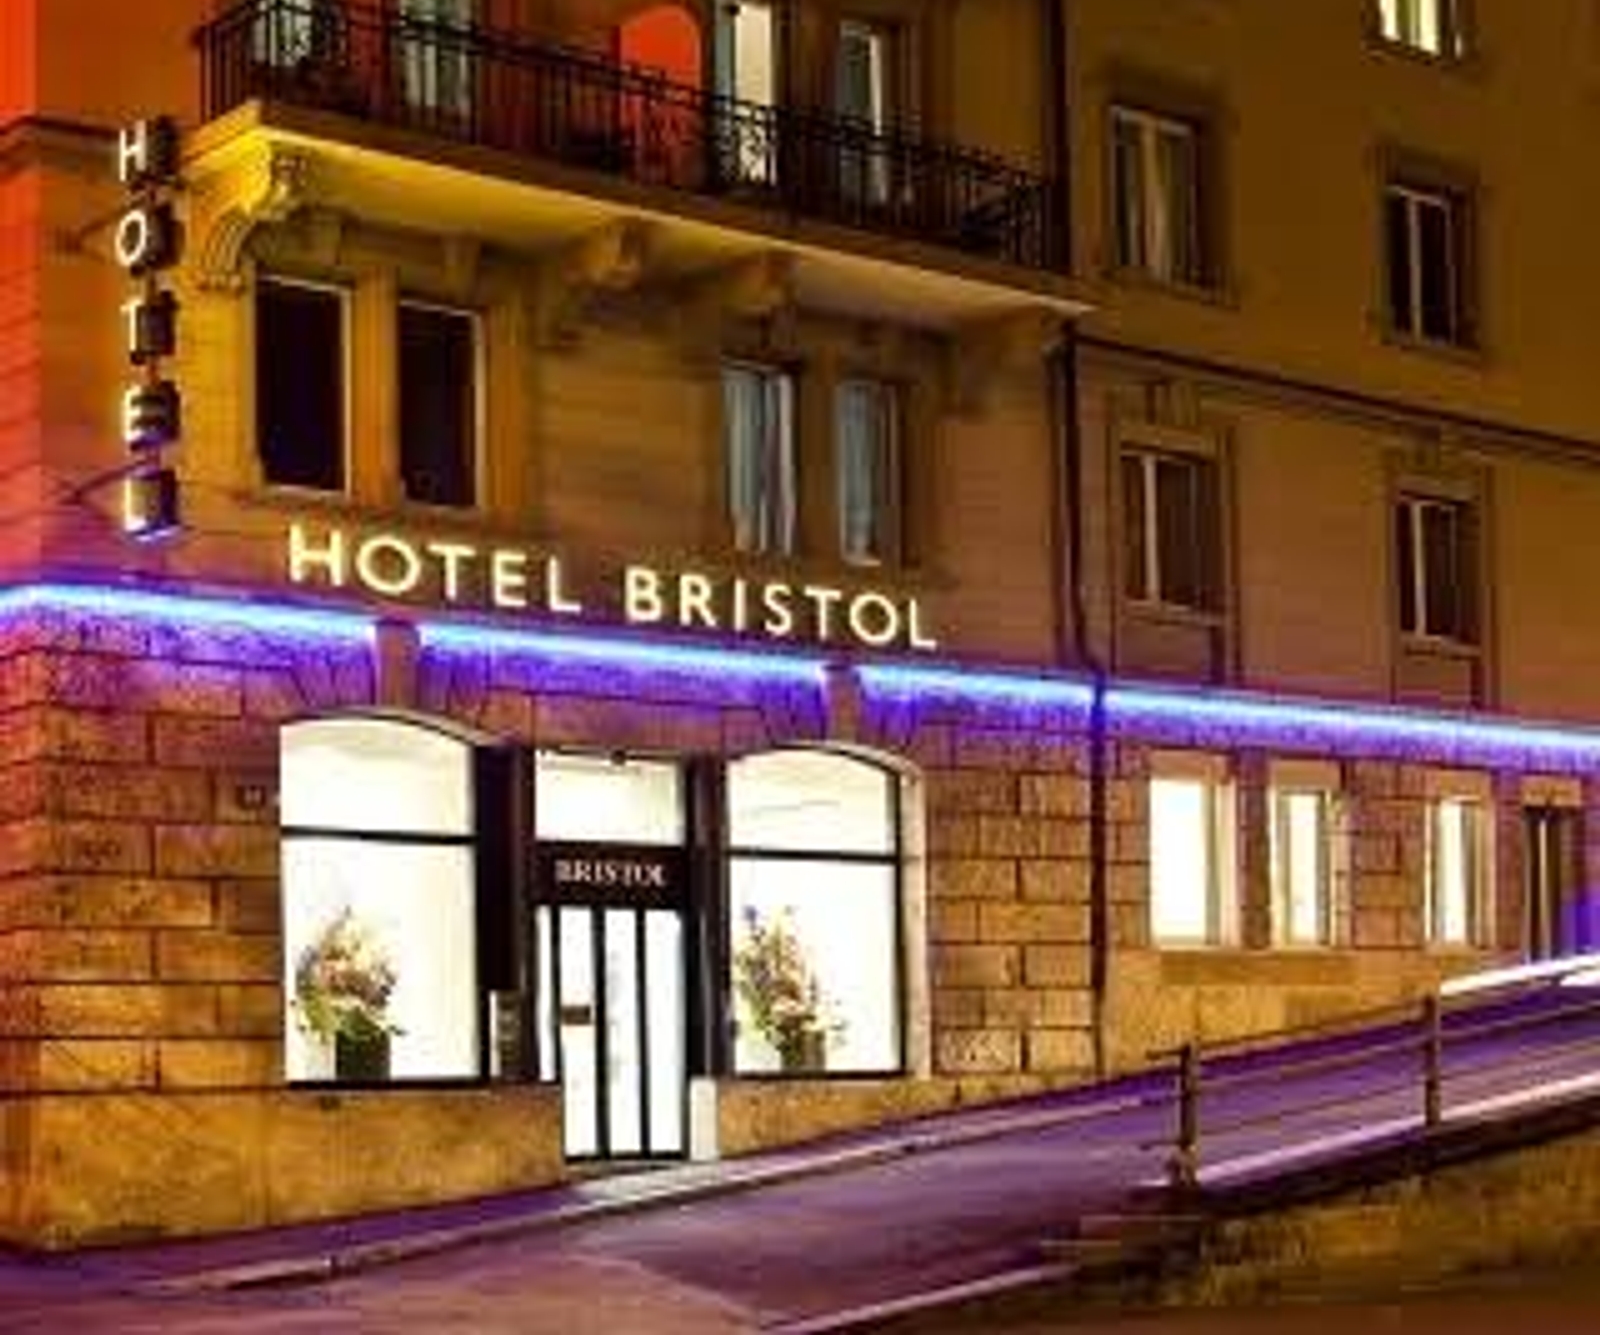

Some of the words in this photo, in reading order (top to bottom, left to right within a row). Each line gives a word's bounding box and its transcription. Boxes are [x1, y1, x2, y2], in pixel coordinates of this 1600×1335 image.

[115, 119, 156, 537] HOTEL
[287, 523, 583, 614] HOTEL
[624, 564, 938, 650] BRISTOL
[554, 858, 665, 888] BRISTOL
